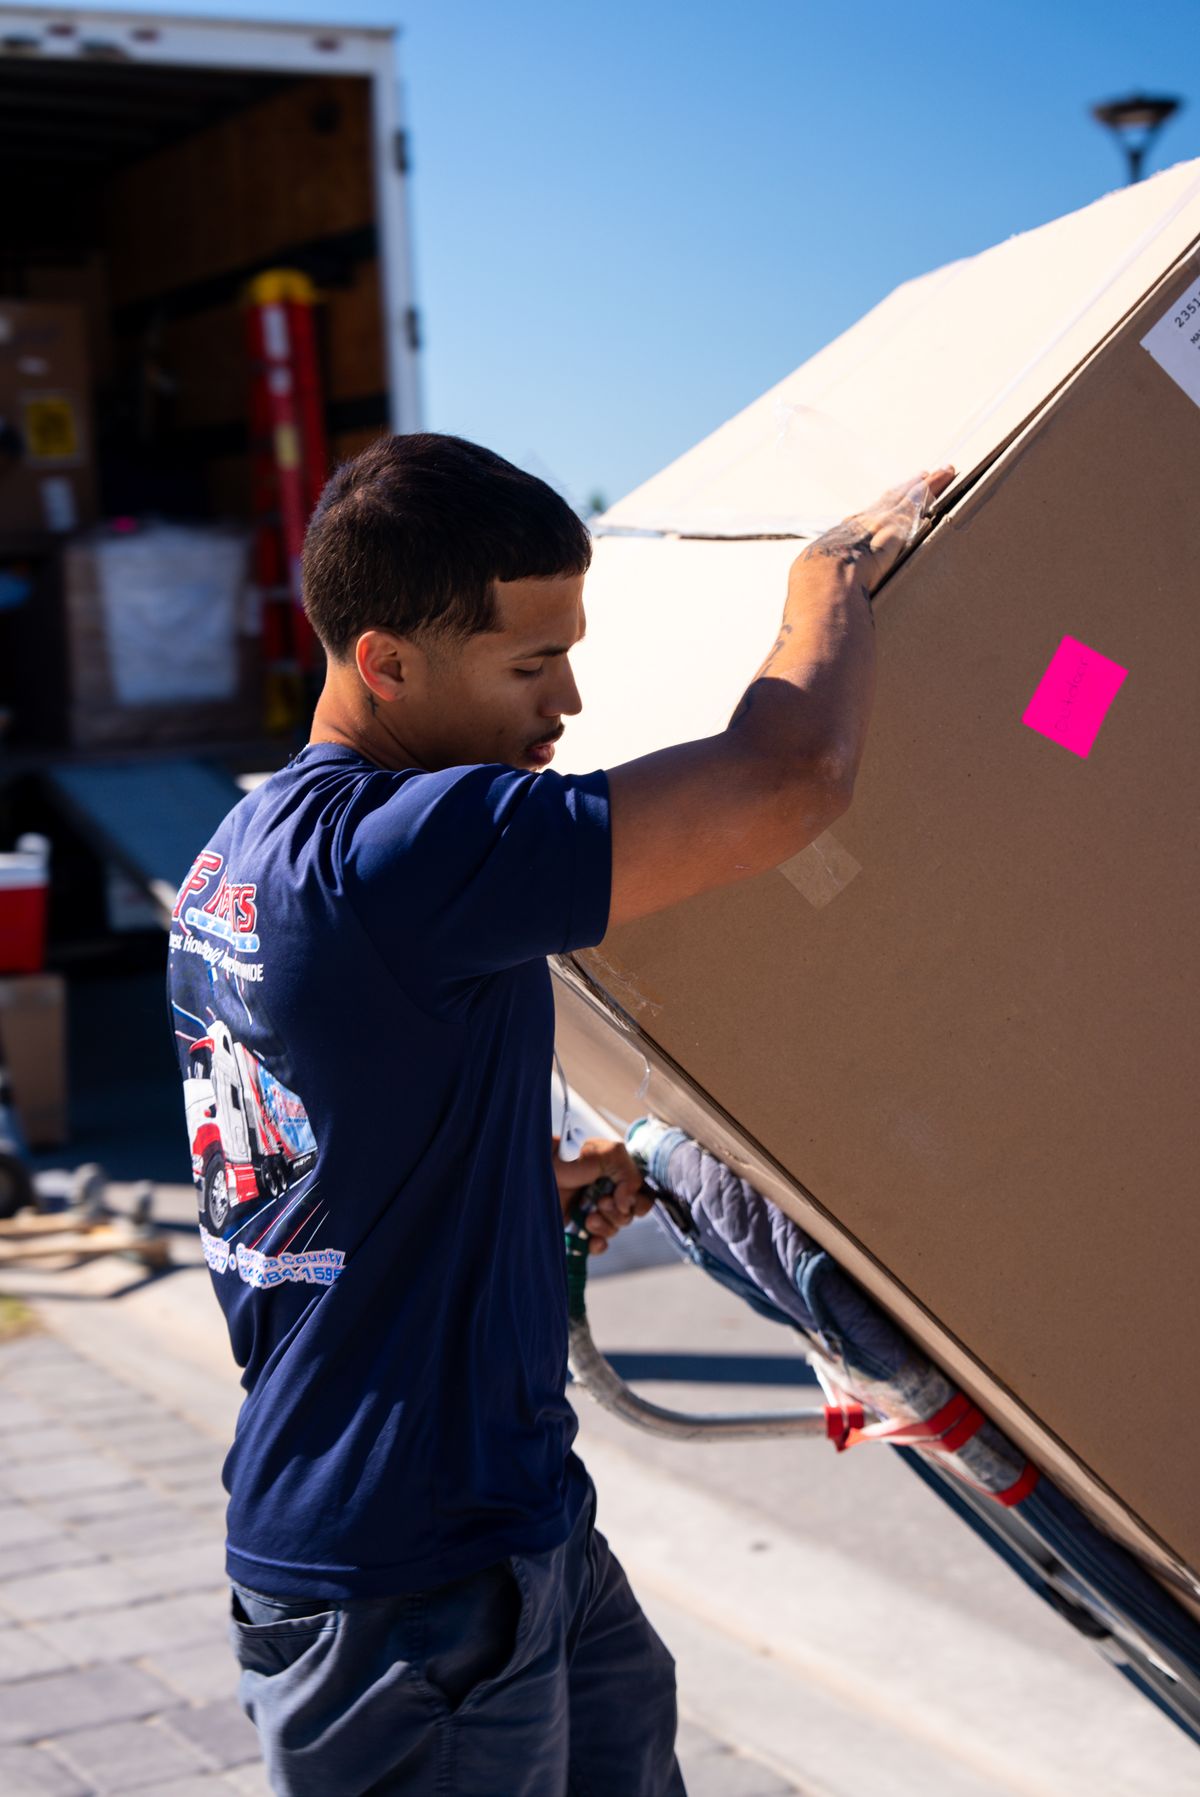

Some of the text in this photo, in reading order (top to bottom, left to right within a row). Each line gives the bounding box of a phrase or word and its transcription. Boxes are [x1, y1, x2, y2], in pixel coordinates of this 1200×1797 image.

[1174, 291, 1200, 328] 2351
[1054, 657, 1089, 733] Outdoor
[279, 1251, 342, 1266] County
